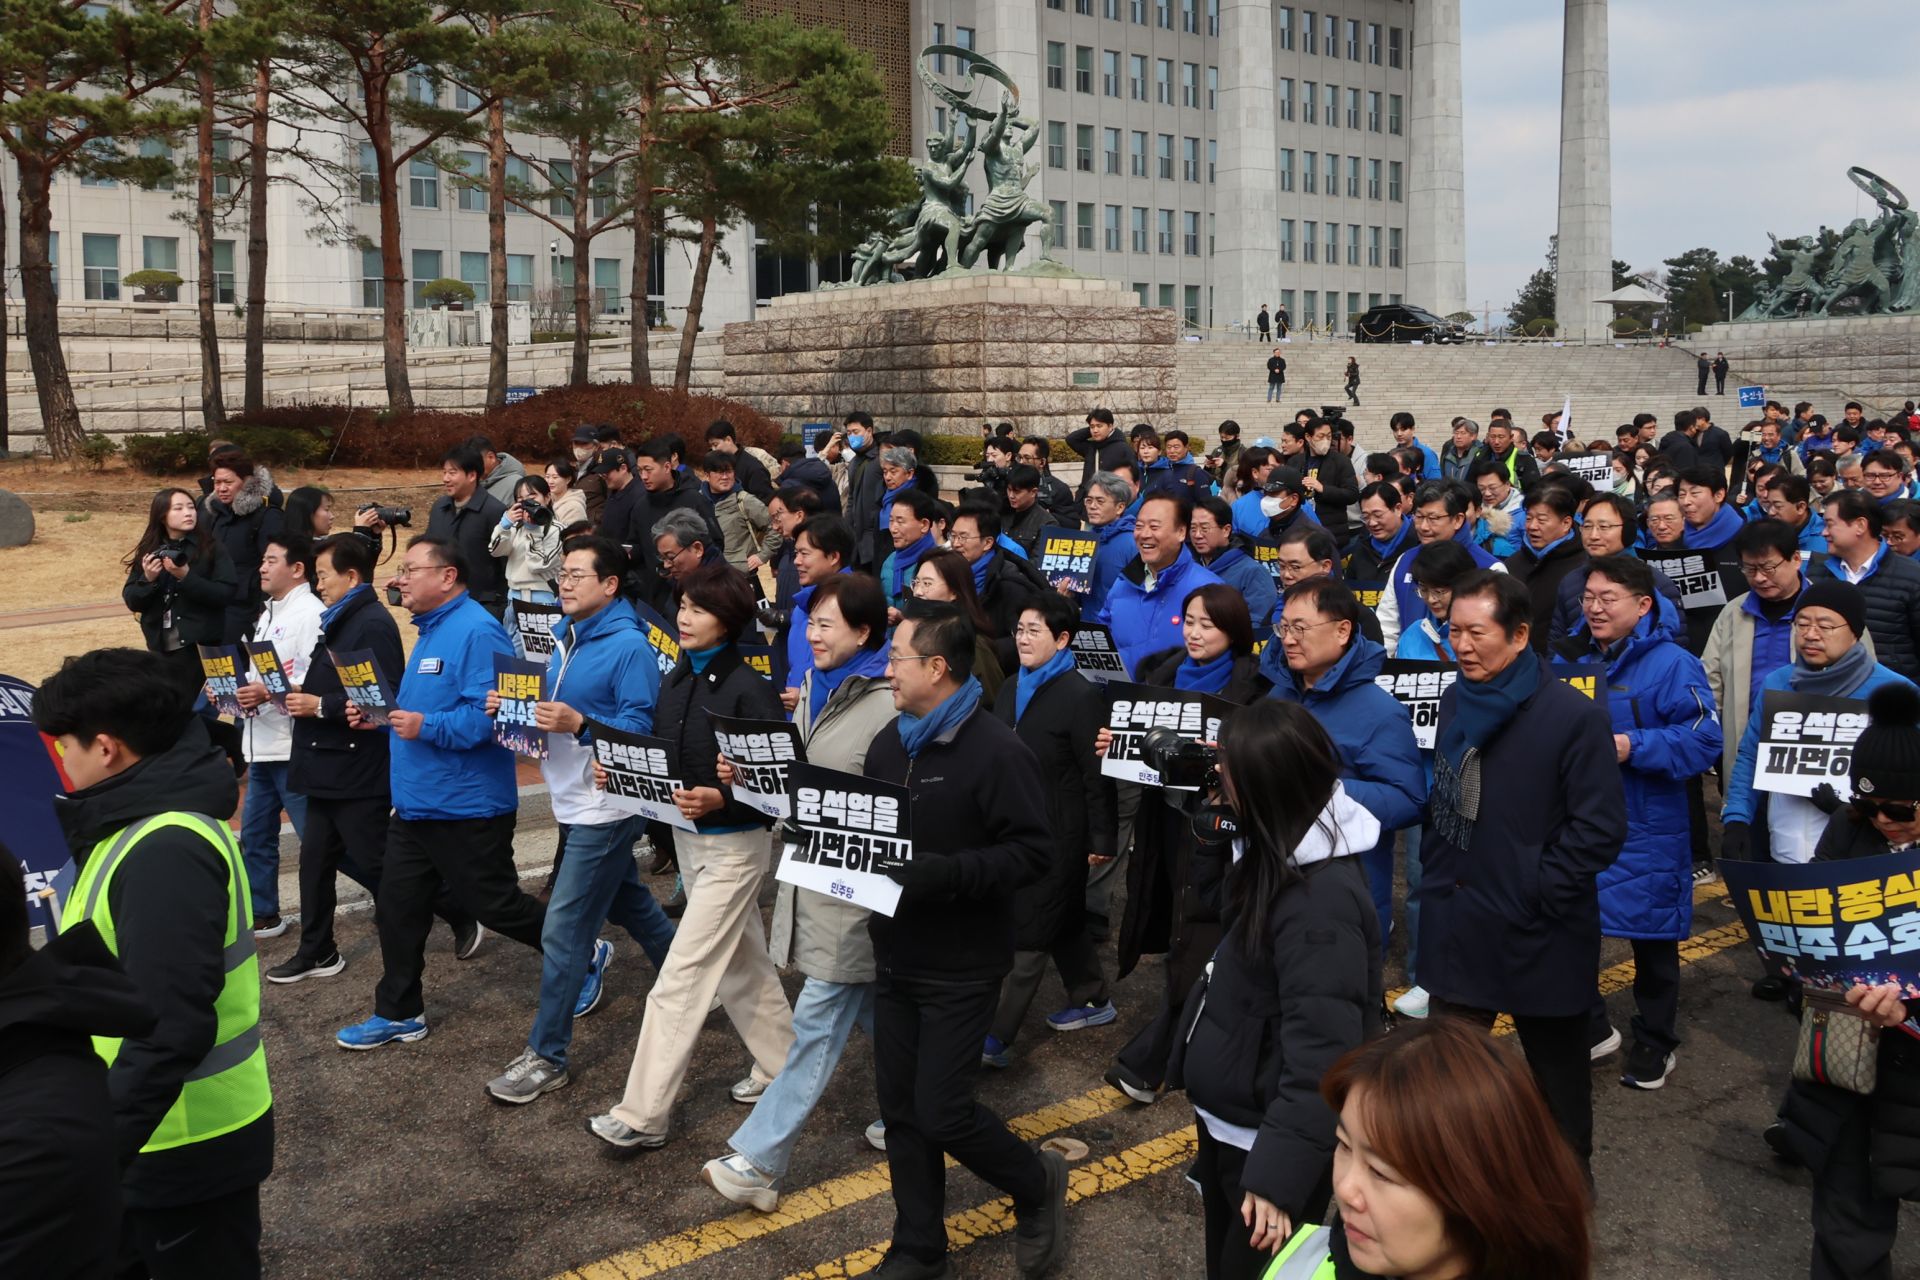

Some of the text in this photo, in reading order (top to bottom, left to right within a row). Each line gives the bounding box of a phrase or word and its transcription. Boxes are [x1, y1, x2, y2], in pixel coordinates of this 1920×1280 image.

[1045, 538, 1096, 557] 내란 종식
[1041, 554, 1091, 573] 민주 수호
[516, 674, 540, 700] 종식
[1110, 700, 1202, 731] 윤석열을
[1770, 711, 1872, 742] 윤석열
[595, 738, 669, 776] 윤석열을
[715, 730, 796, 762] 윤석열을
[797, 787, 899, 834] 윤석열을
[830, 881, 855, 899] 민주당
[1748, 868, 1920, 926] 내란 종식
[1758, 909, 1920, 961] 민주 수호
